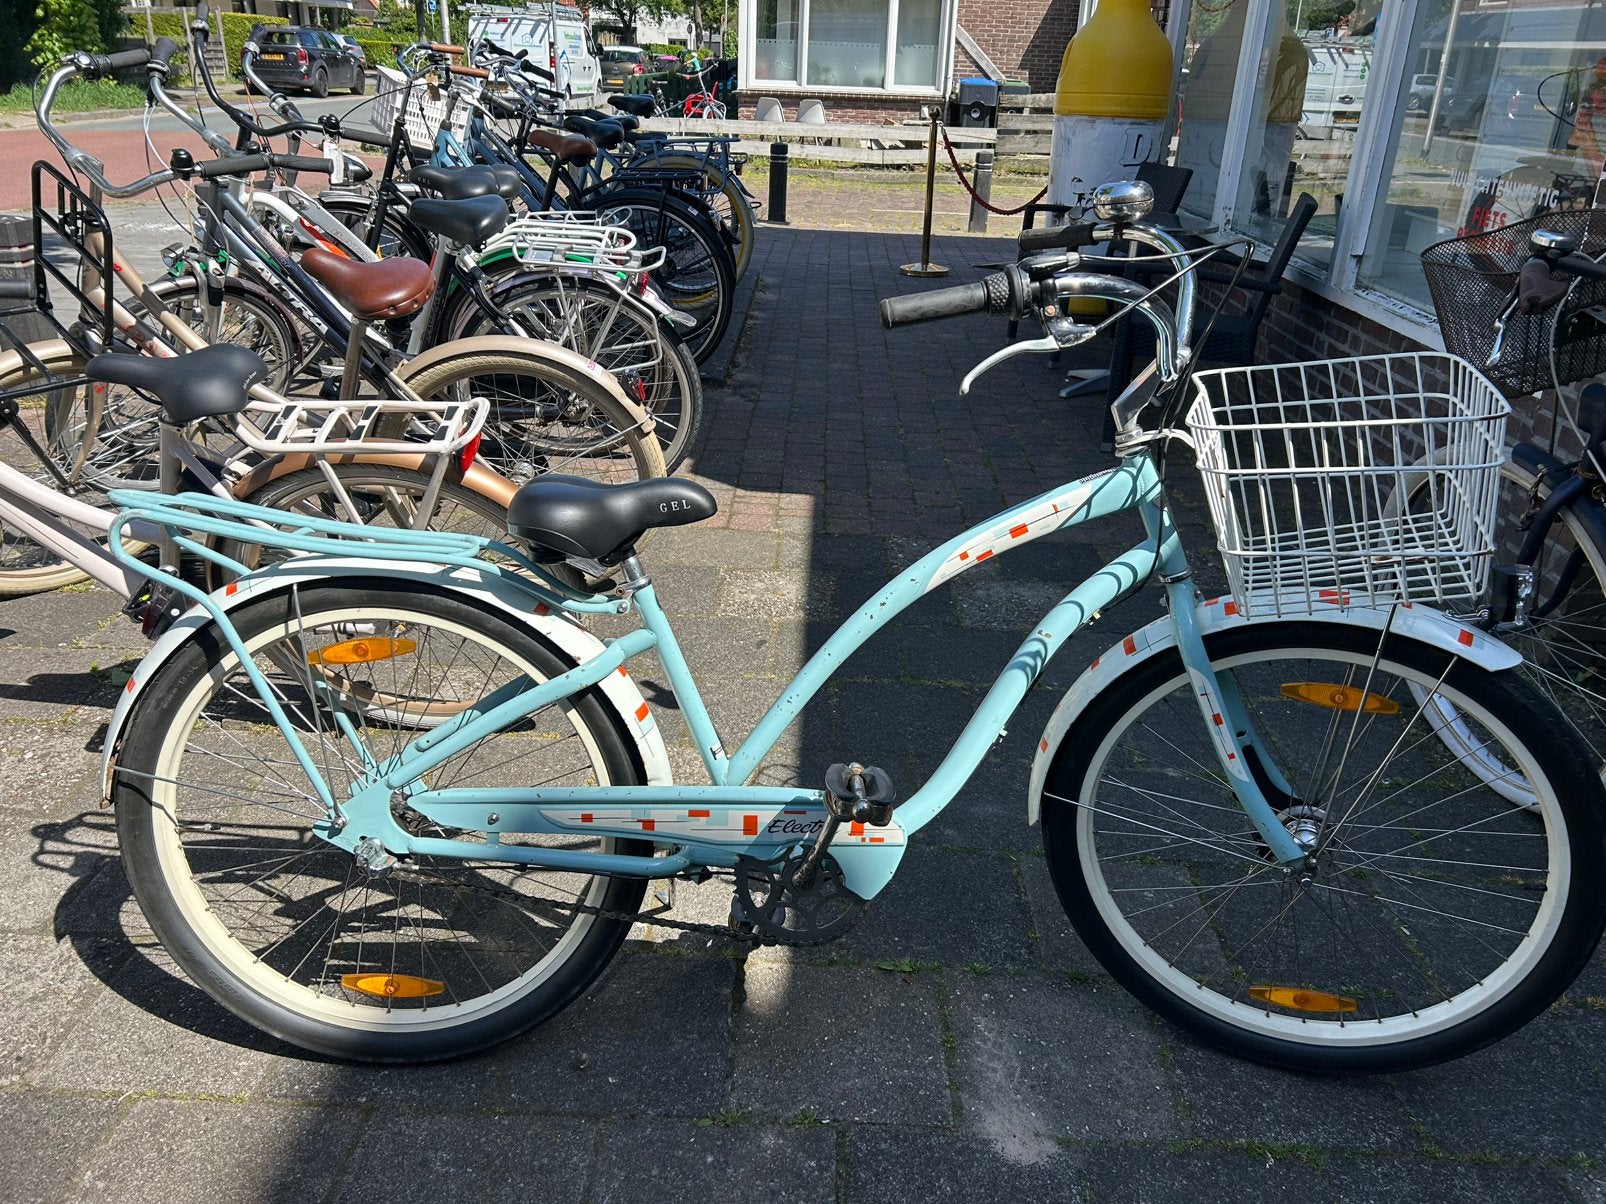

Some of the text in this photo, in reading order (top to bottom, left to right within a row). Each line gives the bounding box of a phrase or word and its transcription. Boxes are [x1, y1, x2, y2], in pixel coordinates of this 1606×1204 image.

[1472, 206, 1508, 229] FIETS
[659, 499, 691, 513] GEL
[767, 819, 840, 834] Elect
